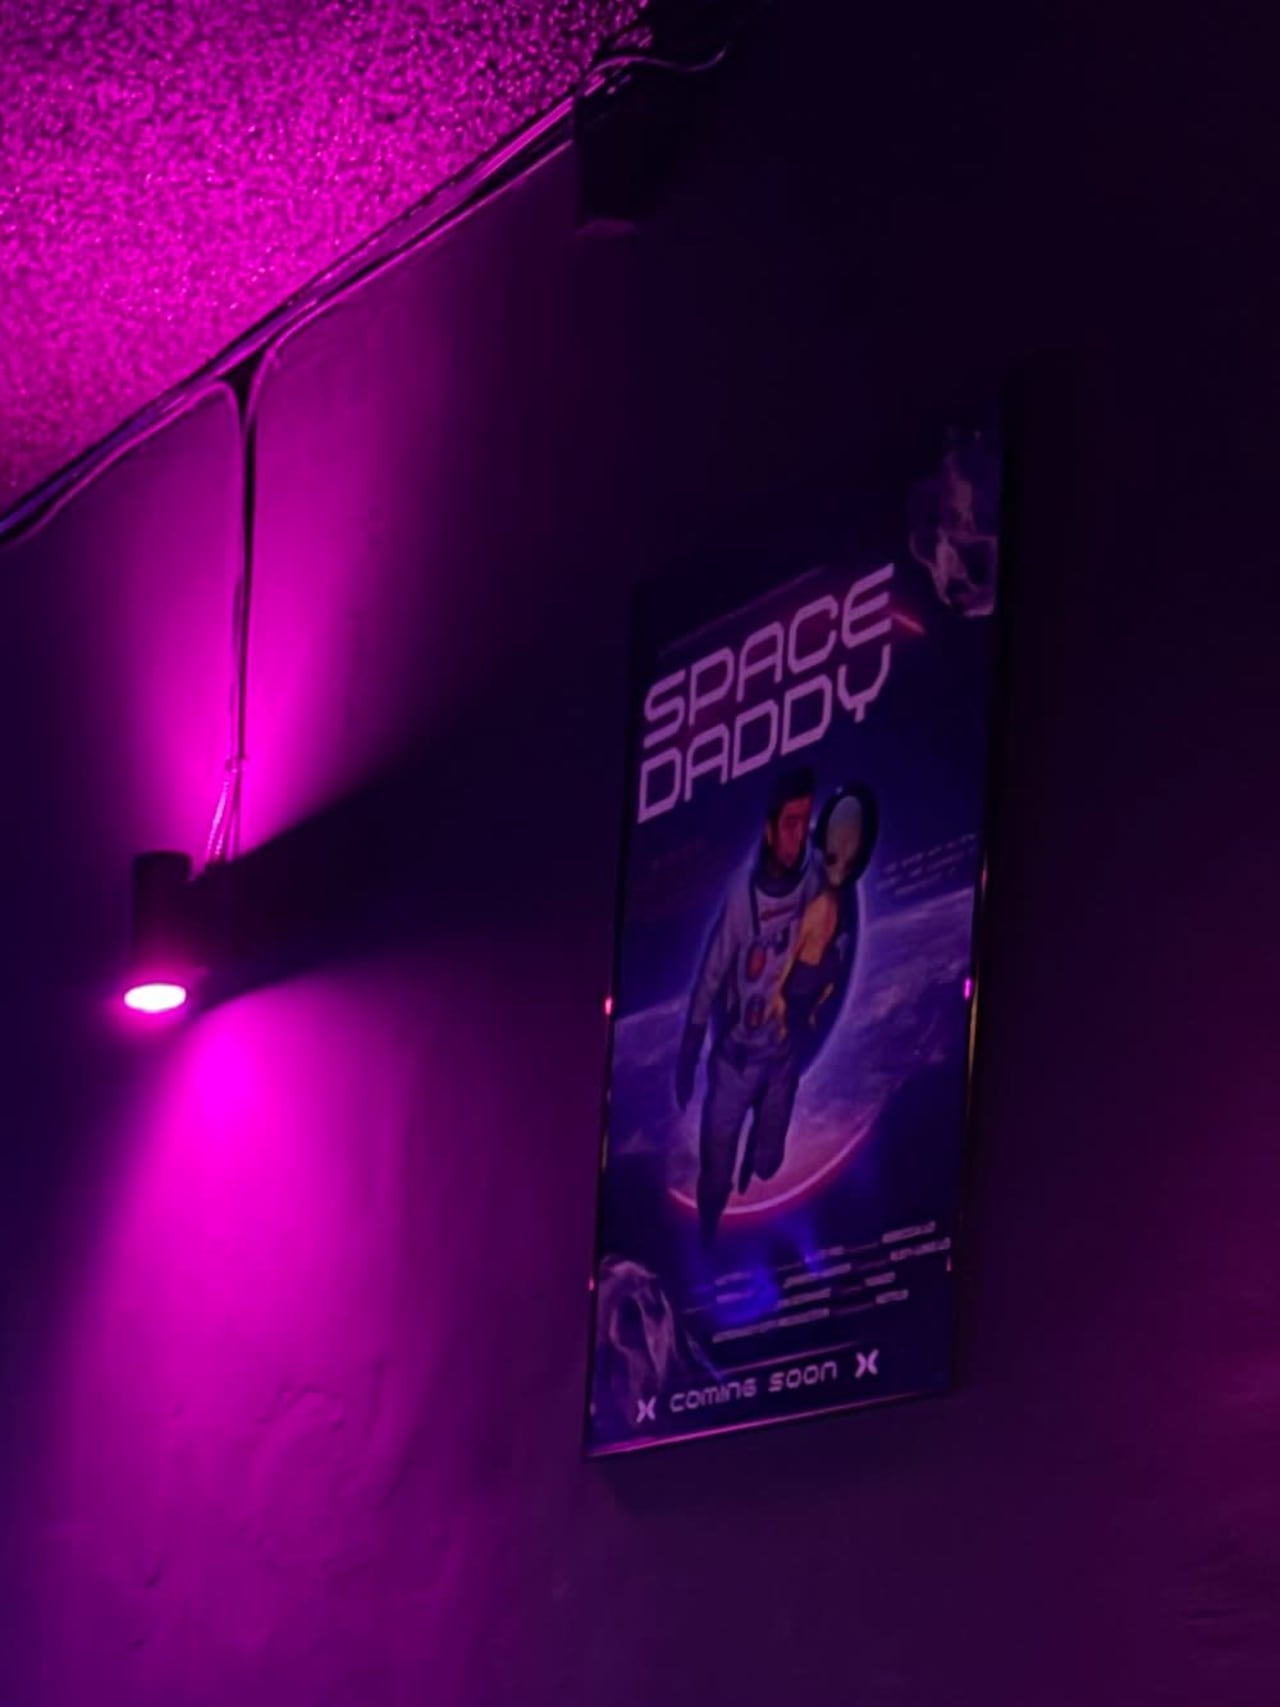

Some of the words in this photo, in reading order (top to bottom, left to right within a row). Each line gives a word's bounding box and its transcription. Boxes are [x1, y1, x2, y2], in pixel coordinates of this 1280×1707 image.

[637, 643, 891, 824] DADDY
[643, 563, 895, 749] SPACE
[670, 1377, 758, 1413] COMING
[768, 1360, 838, 1393] SOON
